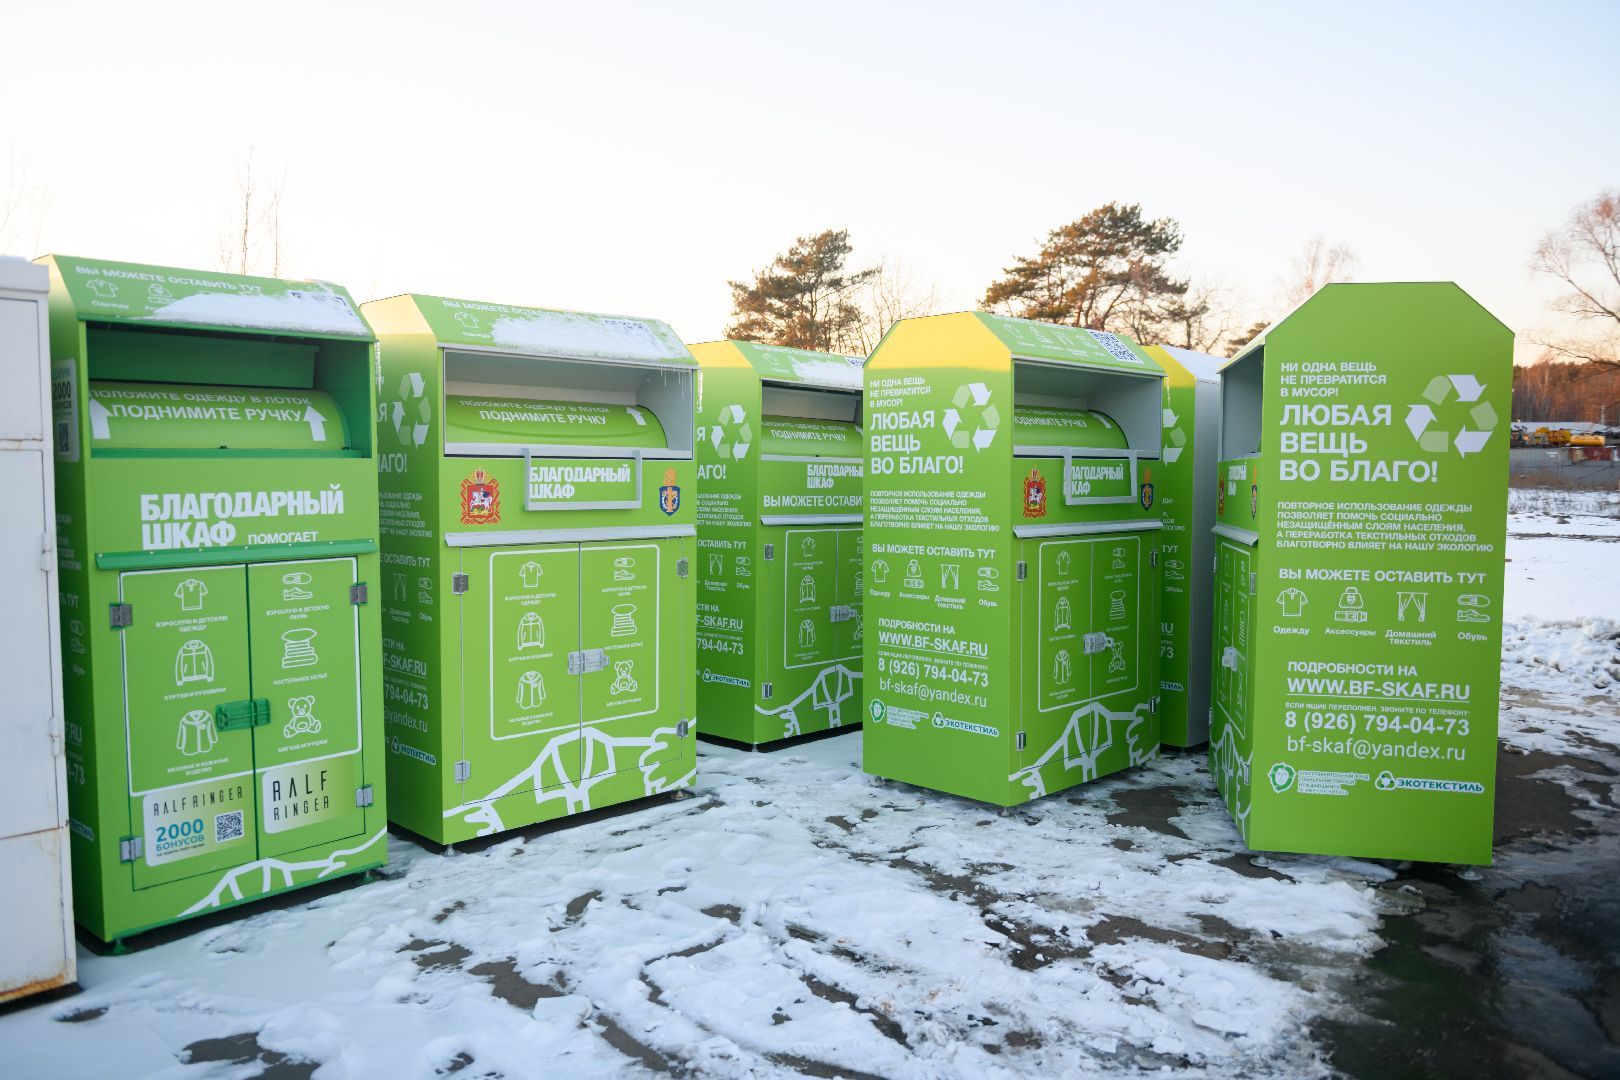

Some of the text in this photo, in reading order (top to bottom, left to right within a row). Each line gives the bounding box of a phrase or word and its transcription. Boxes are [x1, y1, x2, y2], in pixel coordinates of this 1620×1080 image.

[75, 265, 262, 293] ВЫ МОЖЕТЕ ОСТАВИТЬ ТУТ
[1281, 362, 1377, 374] НИ ОДНА ВЕЩЬ
[870, 377, 925, 388] НИ ОДНА ВЕЩЬ
[1281, 374, 1387, 385] НЕ ПРЕВРАТИТСЯ
[89, 389, 312, 406] ПОЛОЖИТЕ ОДЕЖДУ В ЛОТОК
[870, 386, 931, 398] НЕ ПРЕВРАТИТСЯ
[1280, 387, 1338, 398] В МУСОР!
[876, 398, 904, 408] МУСОР!
[112, 404, 302, 421] ПОДНИМИТЕ РУЧКУ
[479, 410, 606, 425] ПОДНИМИТЕ РУЧКУ
[1280, 404, 1392, 426] ЛЮБАЯ
[870, 410, 935, 431] ЛЮБАЯ
[771, 429, 846, 442] ПОДНИМИТЕ РУЧКУ
[871, 434, 921, 455] ВЕЩЬ
[1281, 432, 1368, 458] ВЕЩЬ
[697, 464, 727, 480] АГО!
[871, 456, 964, 474] ВО БЛАГО!
[1279, 459, 1438, 482] ВО БЛАГО!
[529, 464, 631, 483] БЛАГОДАРНЫЙ
[807, 477, 834, 489] ШКАФ
[529, 483, 575, 499] ШКАФ
[956, 491, 986, 499] ОДЕЖДЫ
[141, 484, 344, 521] БЛАГОДАРНЫЙ
[764, 495, 863, 507] ВЫ МОЖЕТЕ ОСТАВИ
[1277, 501, 1472, 513] ПОВТОРНОЕ ИСПОЛЬЗОВАНИЕ ОДЕЖДЫ
[1277, 511, 1442, 522] ПОЗВОЛЯЕТ ПОМОЧЬ СОЦИАЛЬНО
[1365, 521, 1401, 531] СЛОЯМ
[1403, 522, 1466, 533] НАСЕЛЕНИЯ,
[142, 520, 318, 550] ШКАФ ПОМОГАЕТ
[1277, 531, 1477, 543] А ПЕРЕРАБОТКА ТЕКСТИЛЬНЫХ ОТХОДОВ
[697, 539, 746, 550] ОСТАВИТЬ ТУТ
[872, 544, 996, 558] ВЫ МОЖЕТЕ ОСТАВИТЬ ТУТ
[1276, 540, 1493, 553] БЛАГОТВОРНО ВЛИЯЕТ НА НАШУ ЭКОЛОГИЮ
[384, 553, 431, 568] ОСТАВИТЬ ТУТ
[1279, 568, 1486, 584] ВЫ МОЖЕТЕ ОСТАВИТЬ ТУТ
[710, 604, 720, 612] НА
[979, 599, 998, 607] Обувь
[696, 615, 743, 630] F-SKAF.RU
[879, 618, 955, 635] ПОДРОБНОСТИ НА
[1273, 626, 1310, 636] Одежду
[1325, 627, 1376, 637] Аксессуары
[1385, 629, 1437, 639] Домашний
[1458, 632, 1488, 641] Обувь
[697, 638, 744, 655] 794-04-73
[879, 631, 988, 657] WWW.BF-SKAF.RU
[1389, 637, 1432, 647] текстиль
[878, 658, 989, 687] 8 (926) 794-04-73
[1288, 661, 1417, 676] ПОДРОБНОСТИ НА
[880, 677, 987, 708] bf-skaf@yandex.ru
[1287, 677, 1470, 700] WWW.BF-SKAF.RU
[385, 683, 429, 711] 794-04-73
[1380, 706, 1414, 714] ЗВОНИТЕ
[945, 718, 998, 736] ЭКОТЕКСТИЛЬ
[1285, 712, 1470, 736] 8 (926) 794-04-73
[1288, 736, 1465, 761] bf-skaf@yandex.ru
[273, 770, 328, 801] RALF
[1396, 778, 1483, 792] ЭКОТЕКСТИЛЬ
[273, 795, 330, 821] RINGER
[155, 818, 204, 843] 2000
[156, 834, 205, 852] БОНУСОВ
